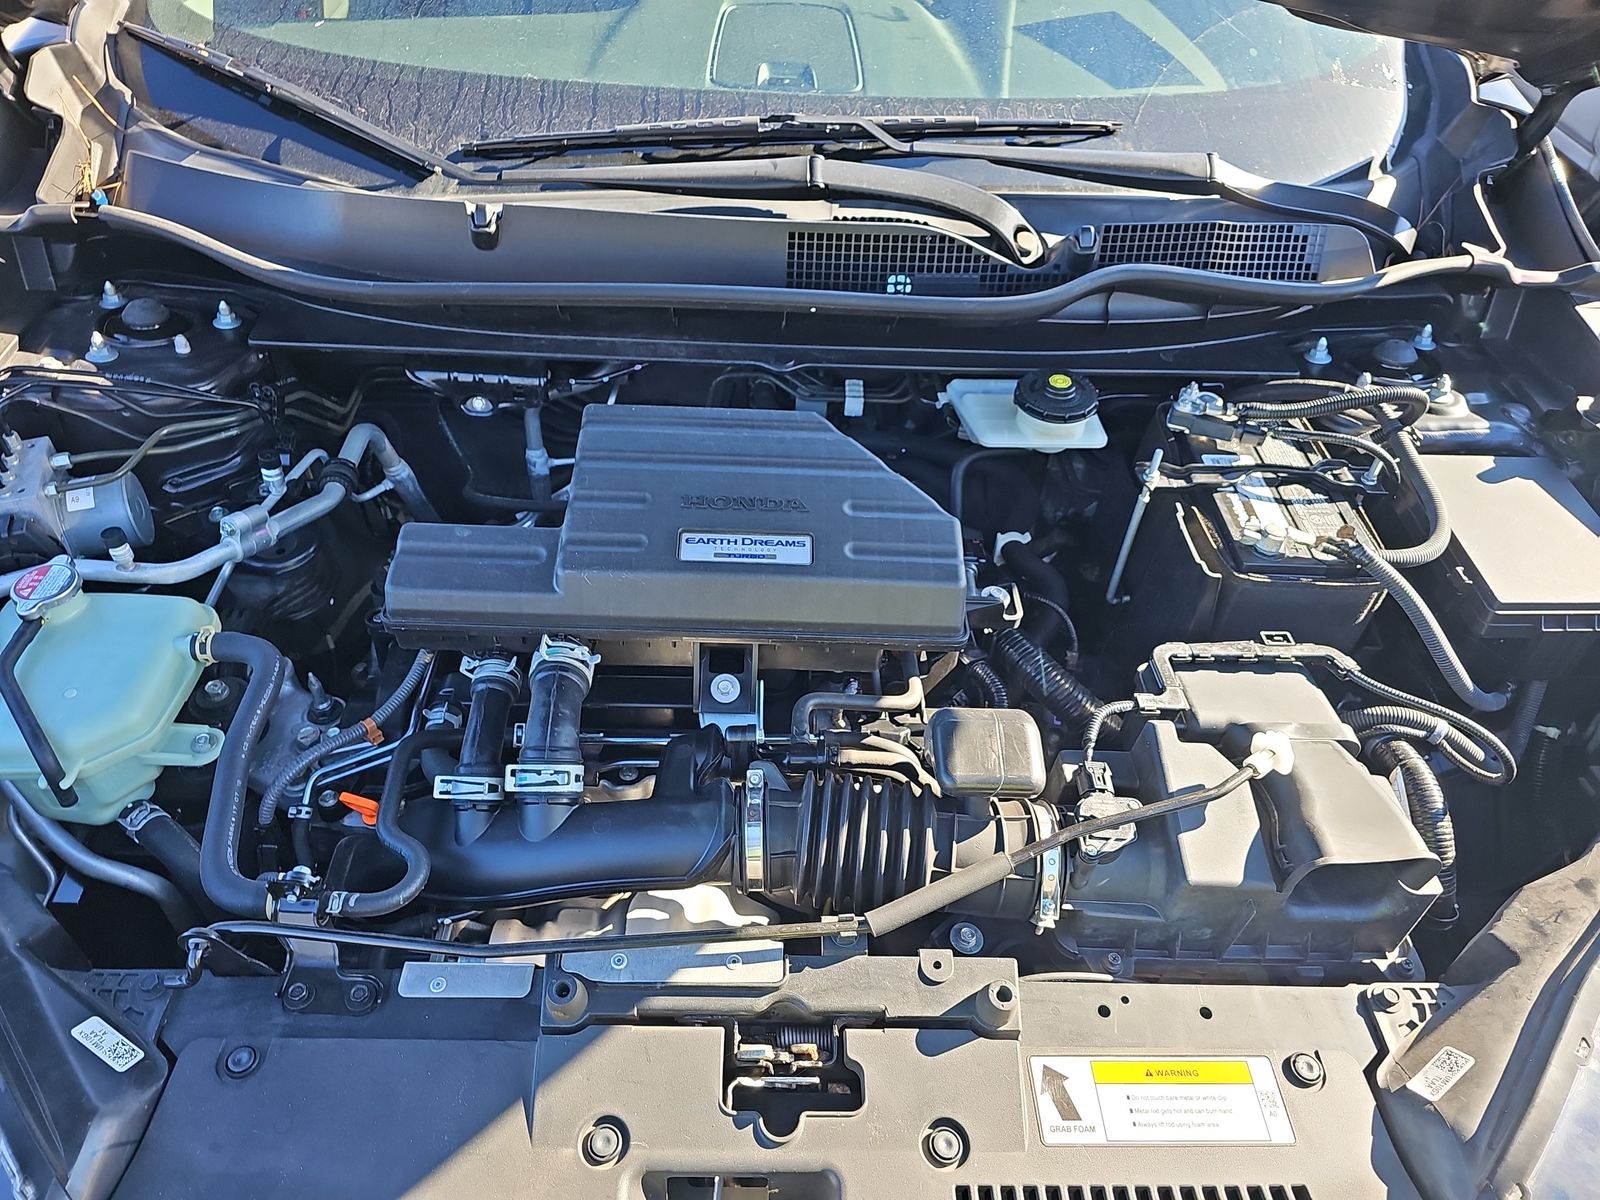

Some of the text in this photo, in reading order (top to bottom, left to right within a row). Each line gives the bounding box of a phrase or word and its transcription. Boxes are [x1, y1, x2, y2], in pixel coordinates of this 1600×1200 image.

[680, 494, 810, 513] HONDA
[685, 537, 806, 548] EARTH DREAMS
[89, 1029, 106, 1044] TLAA
[1155, 1069, 1200, 1078] WARNING
[1050, 1125, 1096, 1133] GRAB FOAM
[1138, 1120, 1157, 1128] Always
